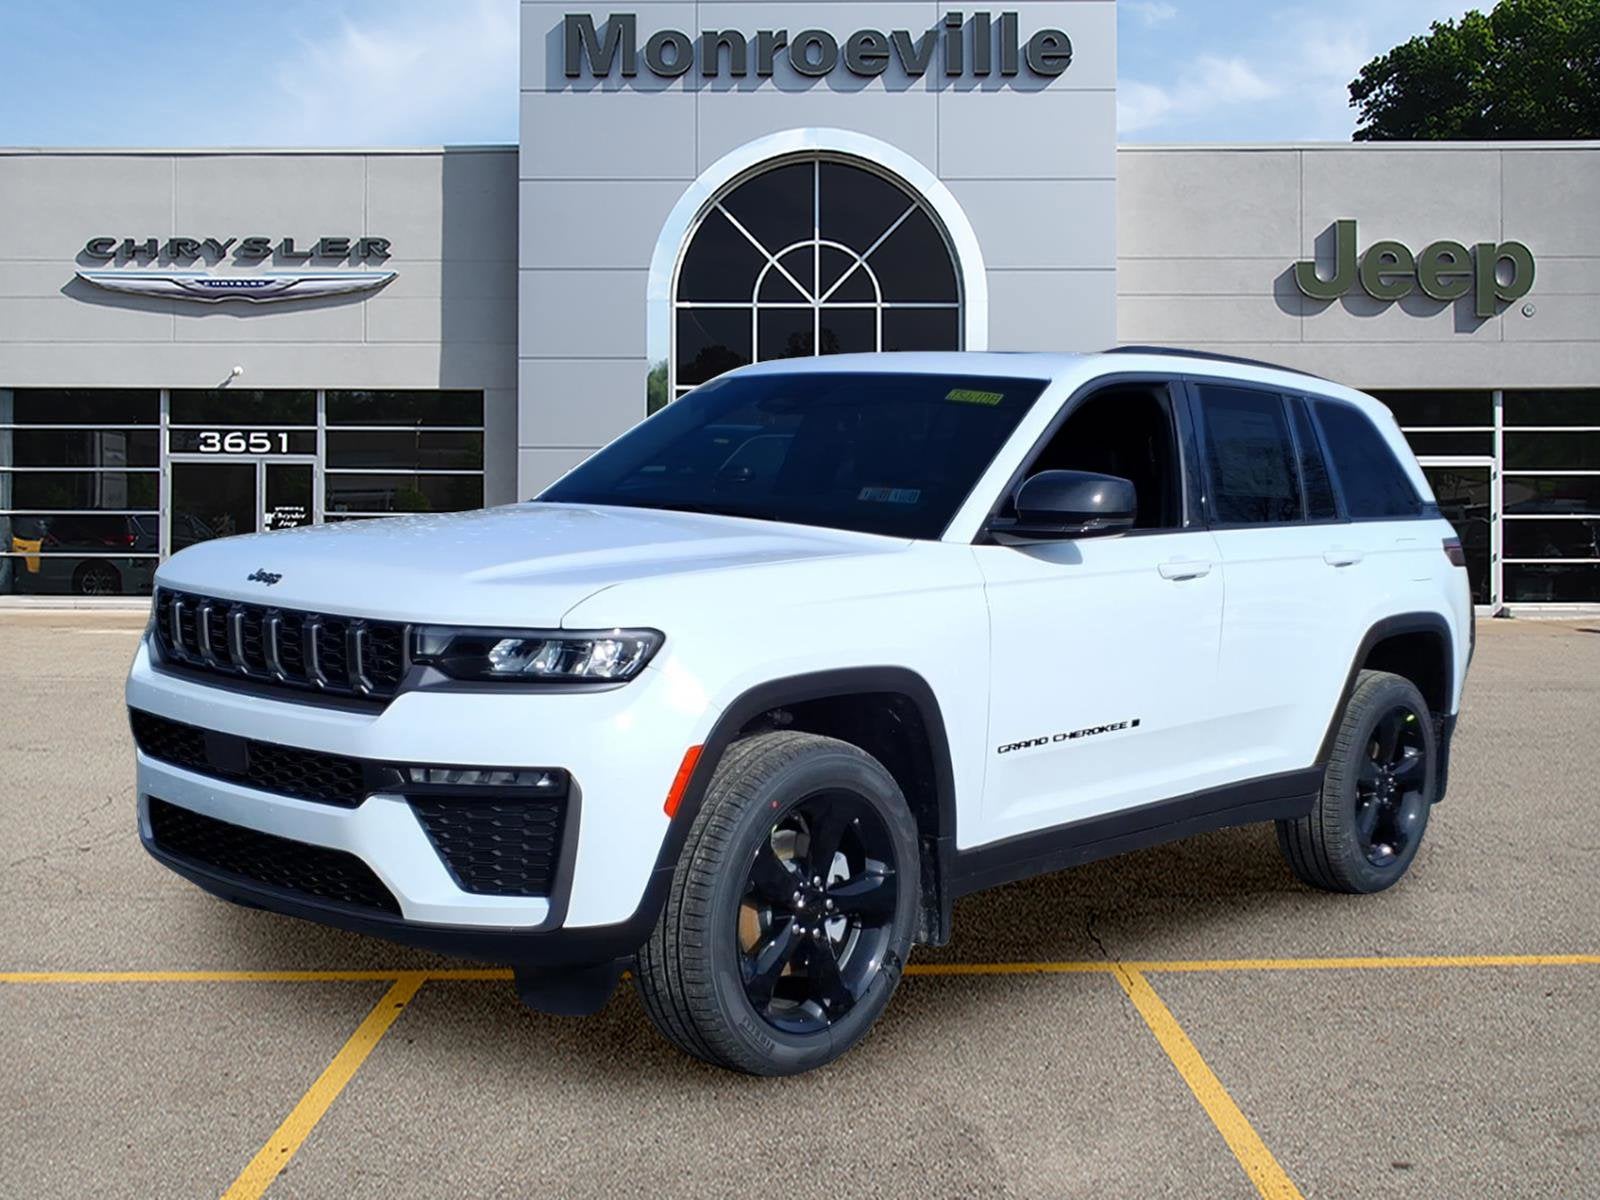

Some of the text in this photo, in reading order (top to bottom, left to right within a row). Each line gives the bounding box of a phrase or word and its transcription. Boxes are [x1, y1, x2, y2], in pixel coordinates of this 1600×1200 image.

[564, 12, 1074, 78] Monroeville
[85, 237, 392, 259] CHRYSLER
[1294, 219, 1536, 318] Jeep
[199, 431, 289, 454] 3651
[247, 568, 282, 586] Jeep
[997, 721, 1128, 754] GRAND CHEROKEE
